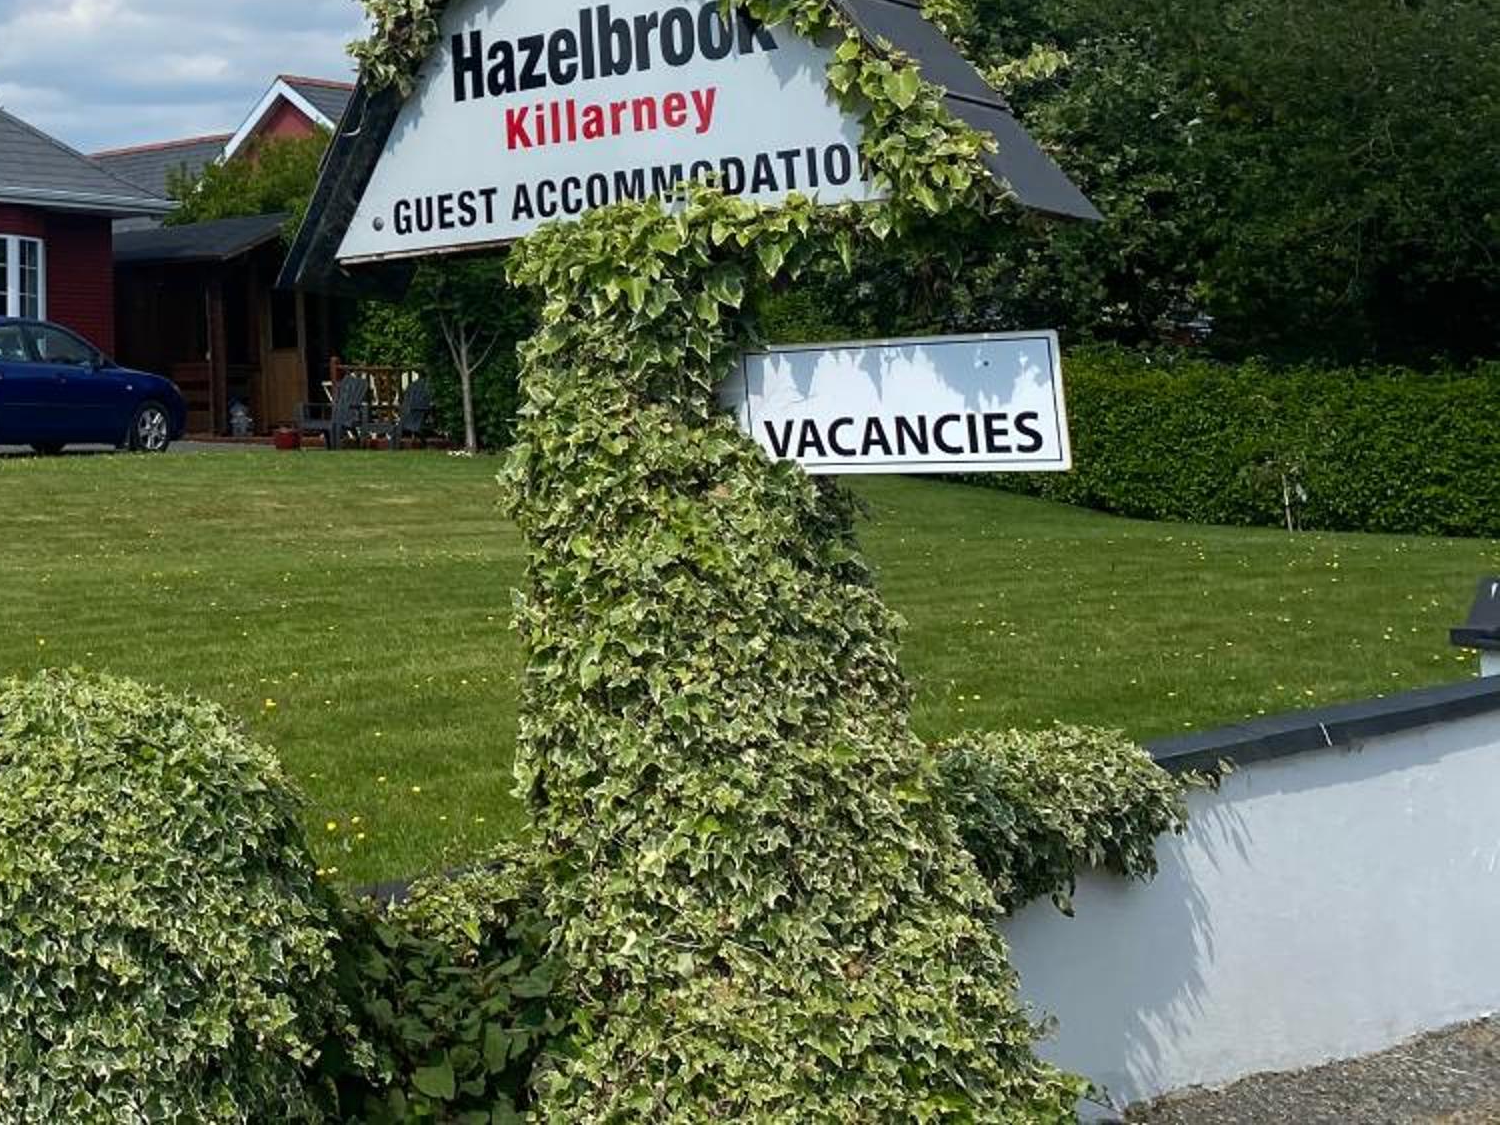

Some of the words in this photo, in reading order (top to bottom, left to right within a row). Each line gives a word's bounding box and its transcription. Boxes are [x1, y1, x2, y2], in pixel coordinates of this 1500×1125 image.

[505, 86, 717, 150] Killarney
[393, 187, 498, 236] GUEST
[763, 410, 1044, 458] VACANCIES
